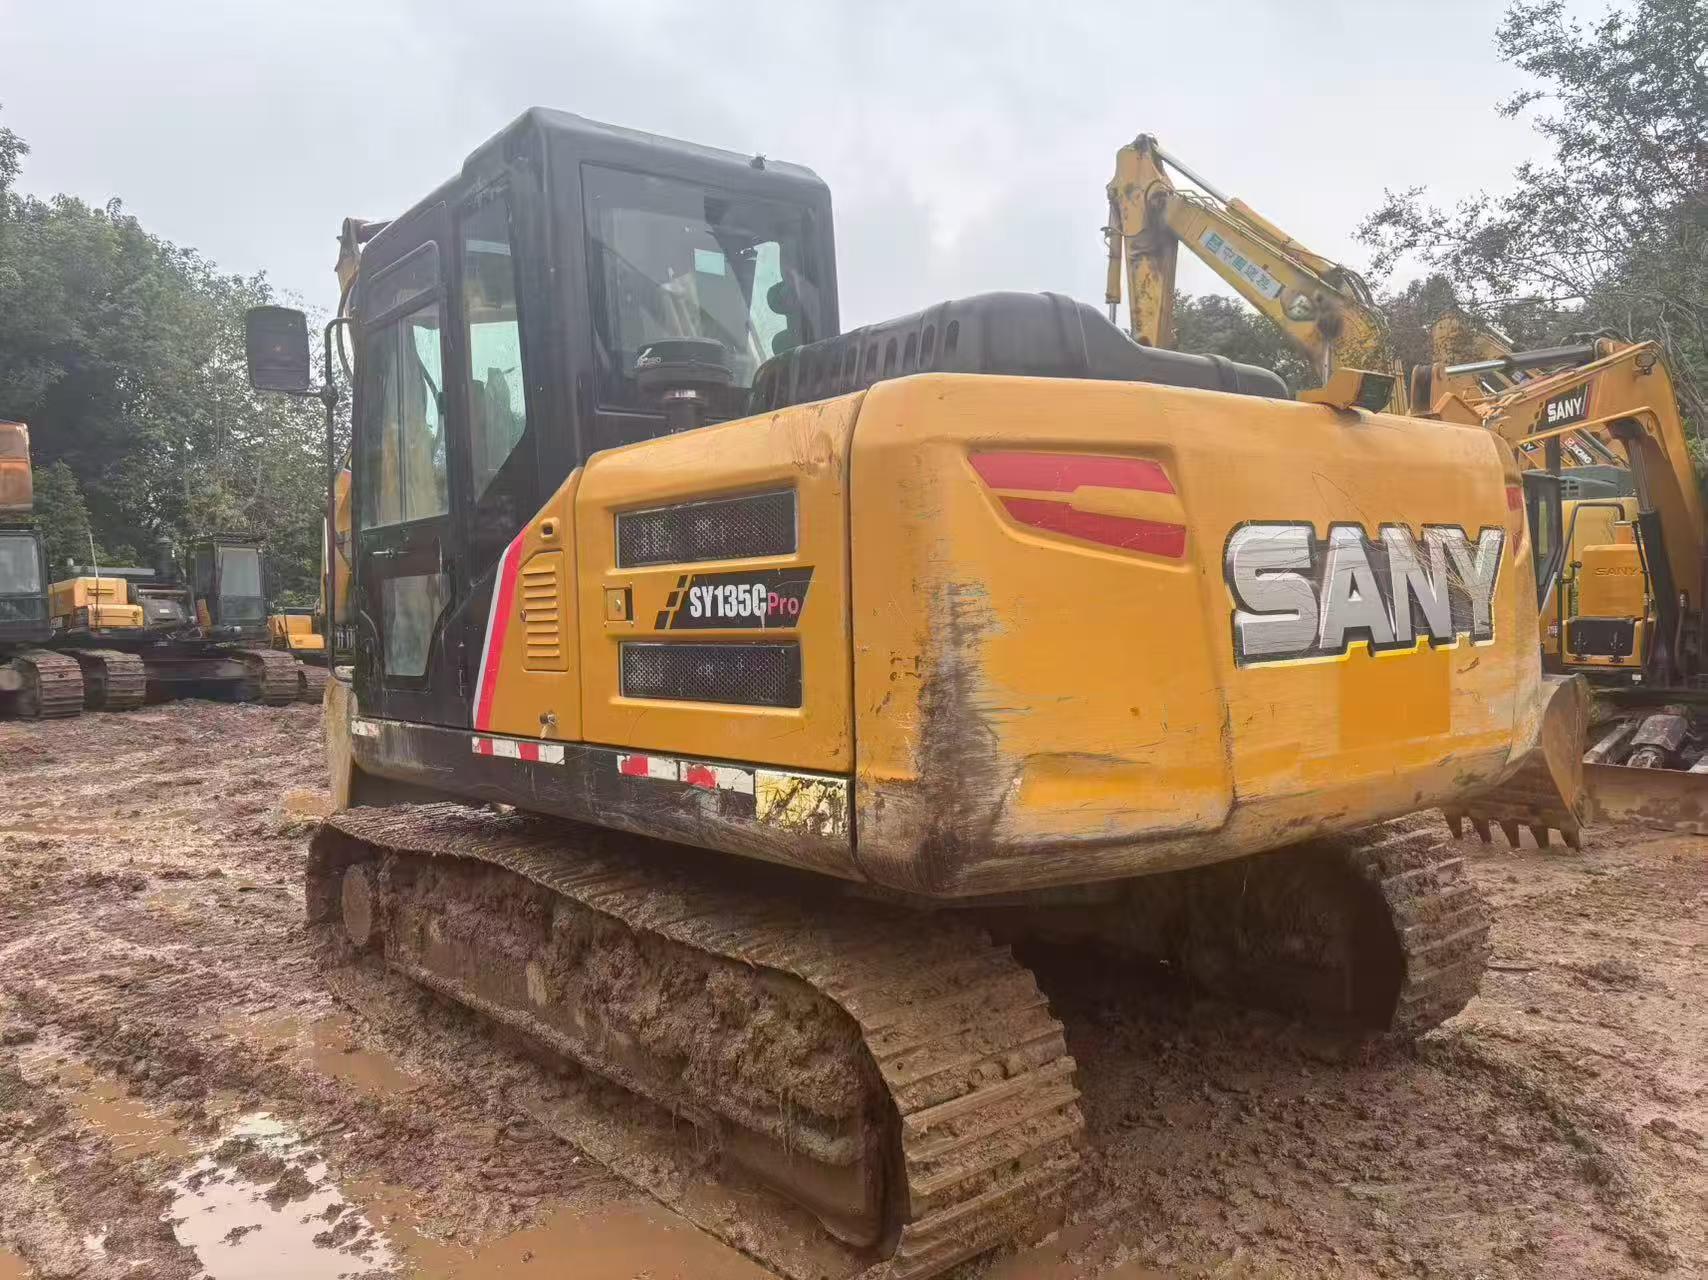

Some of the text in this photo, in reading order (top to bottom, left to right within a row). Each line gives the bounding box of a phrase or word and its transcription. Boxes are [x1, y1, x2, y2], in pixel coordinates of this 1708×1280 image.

[1547, 397, 1582, 423] SANY
[1593, 567, 1642, 577] SANY
[1223, 521, 1505, 663] SANY
